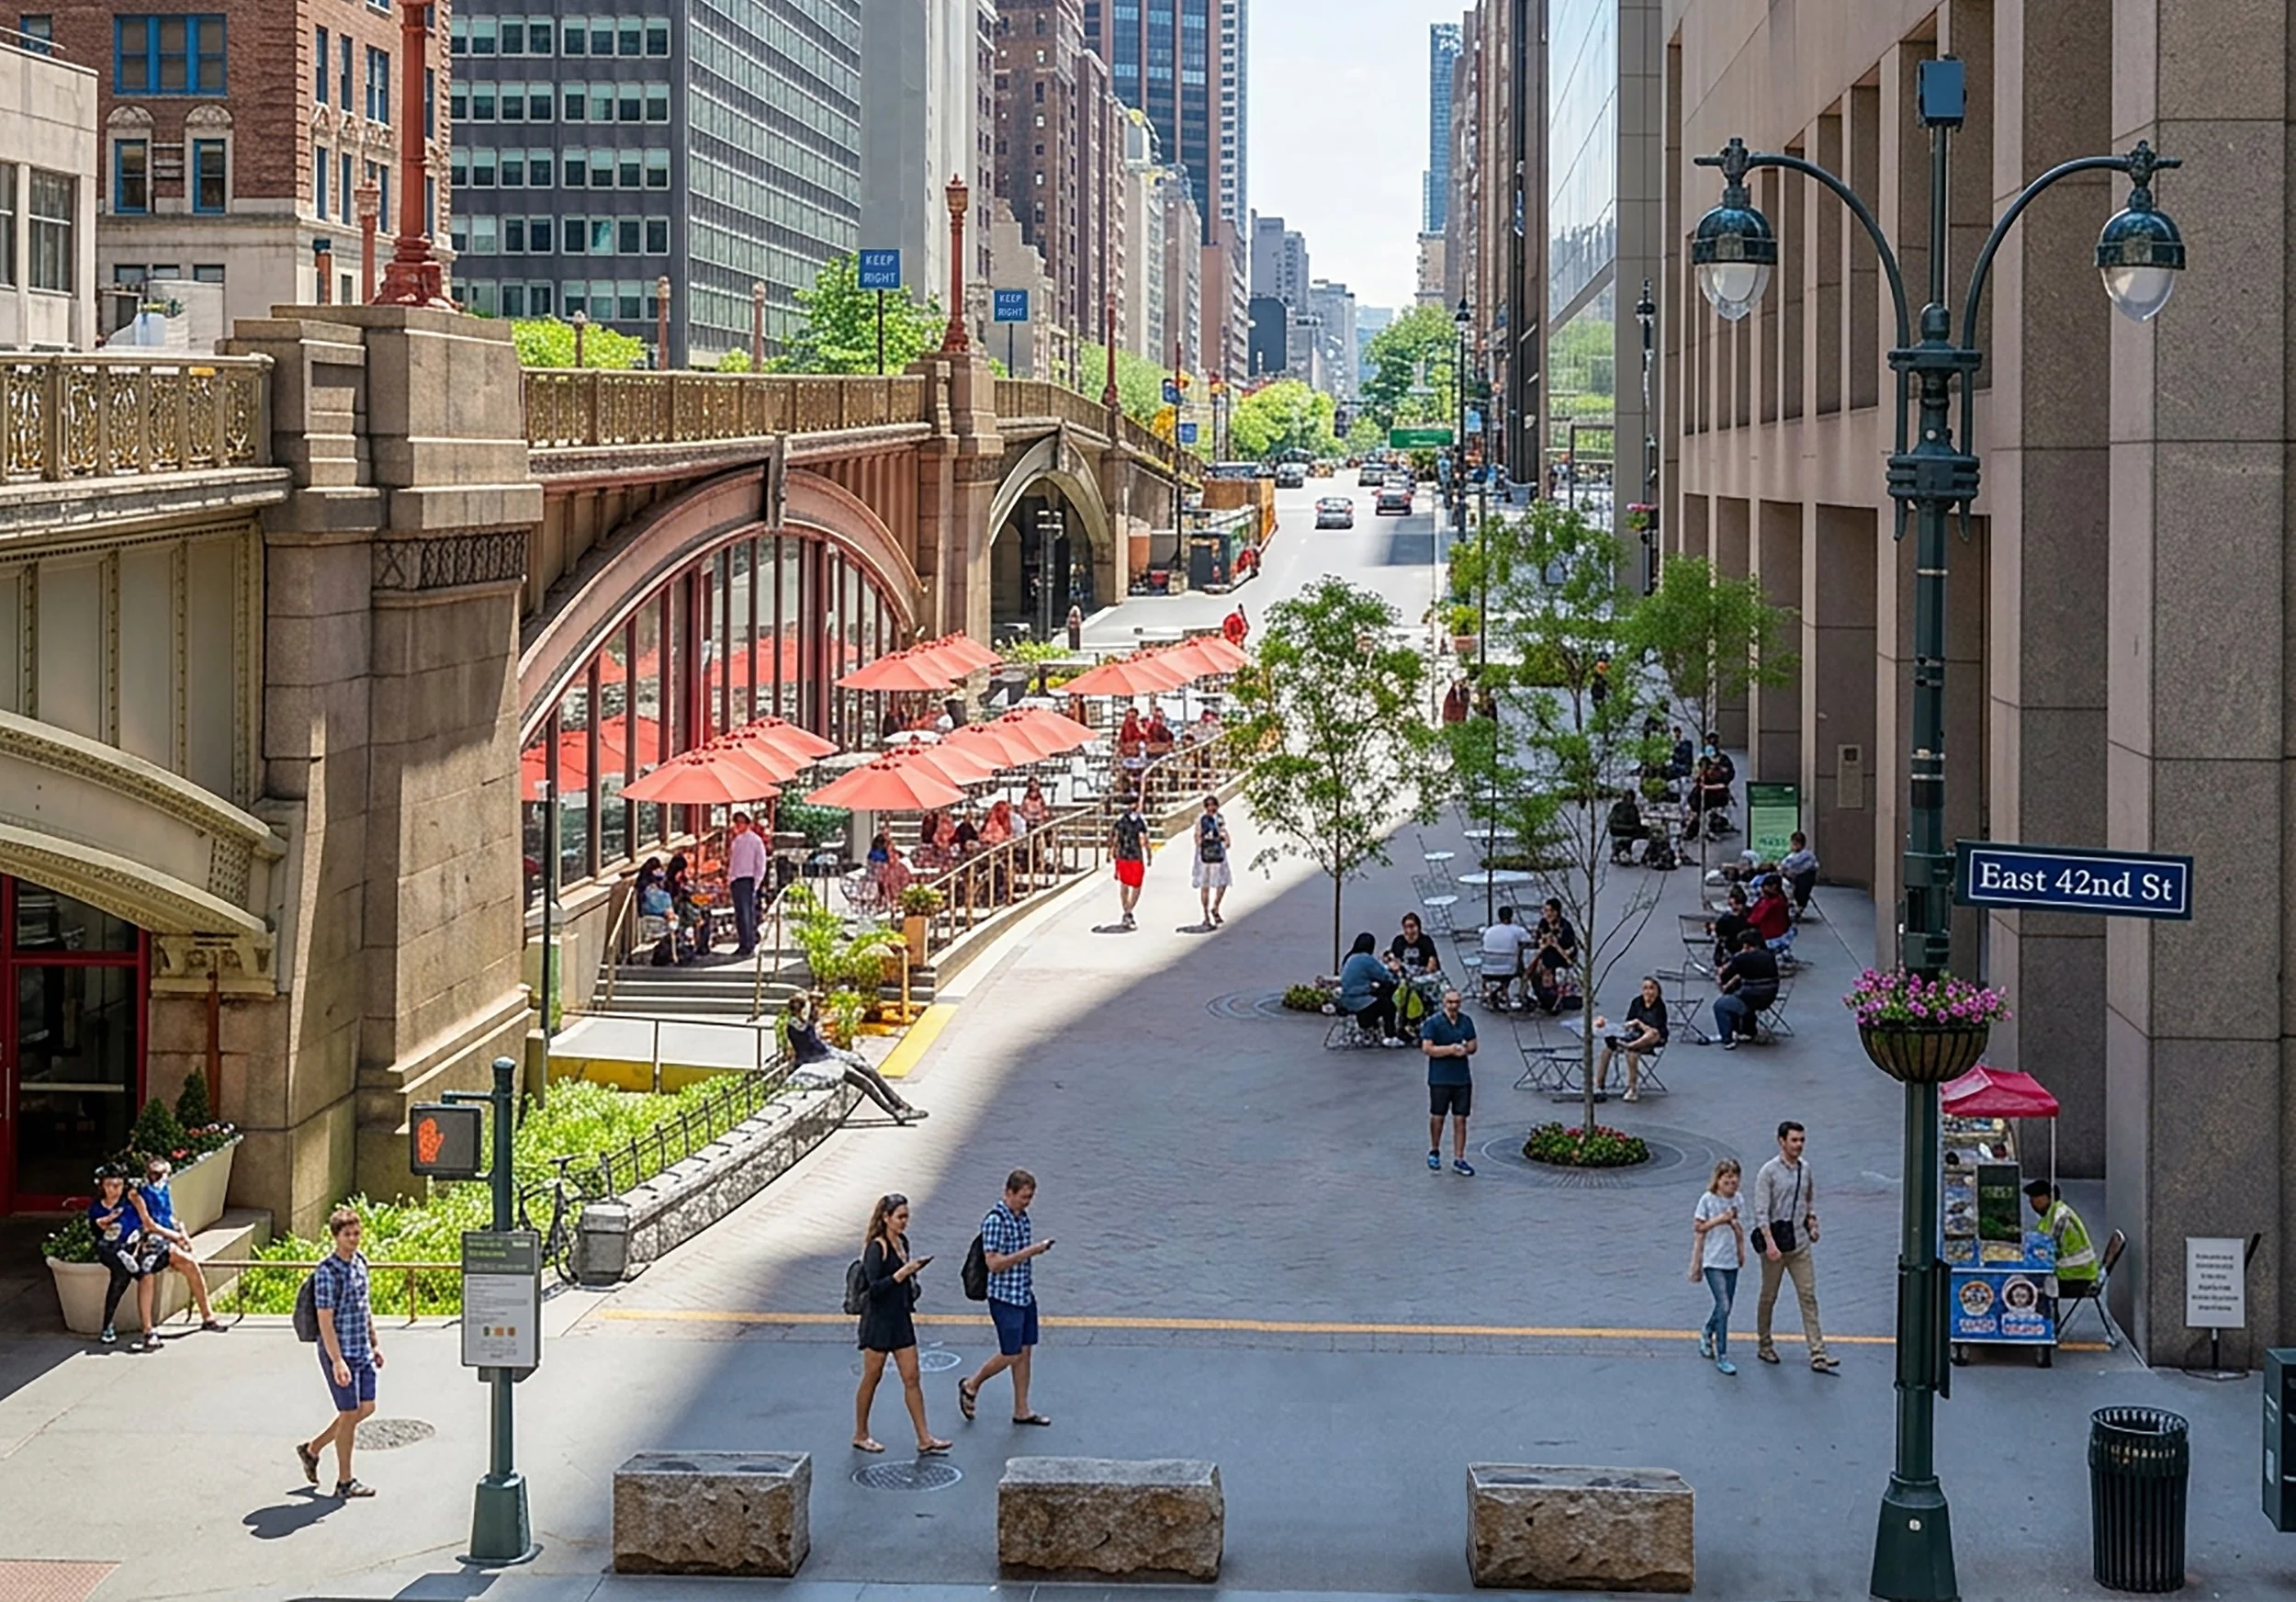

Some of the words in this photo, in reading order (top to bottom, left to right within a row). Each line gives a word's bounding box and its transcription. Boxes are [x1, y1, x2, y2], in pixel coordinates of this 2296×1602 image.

[865, 254, 895, 265] KEEP
[863, 273, 895, 284] RIGHT
[999, 294, 1022, 302] KEEP
[997, 308, 1024, 316] RIGHT
[1979, 862, 2047, 892] East
[2054, 869, 2133, 898] 42nd
[2141, 874, 2173, 901] St
